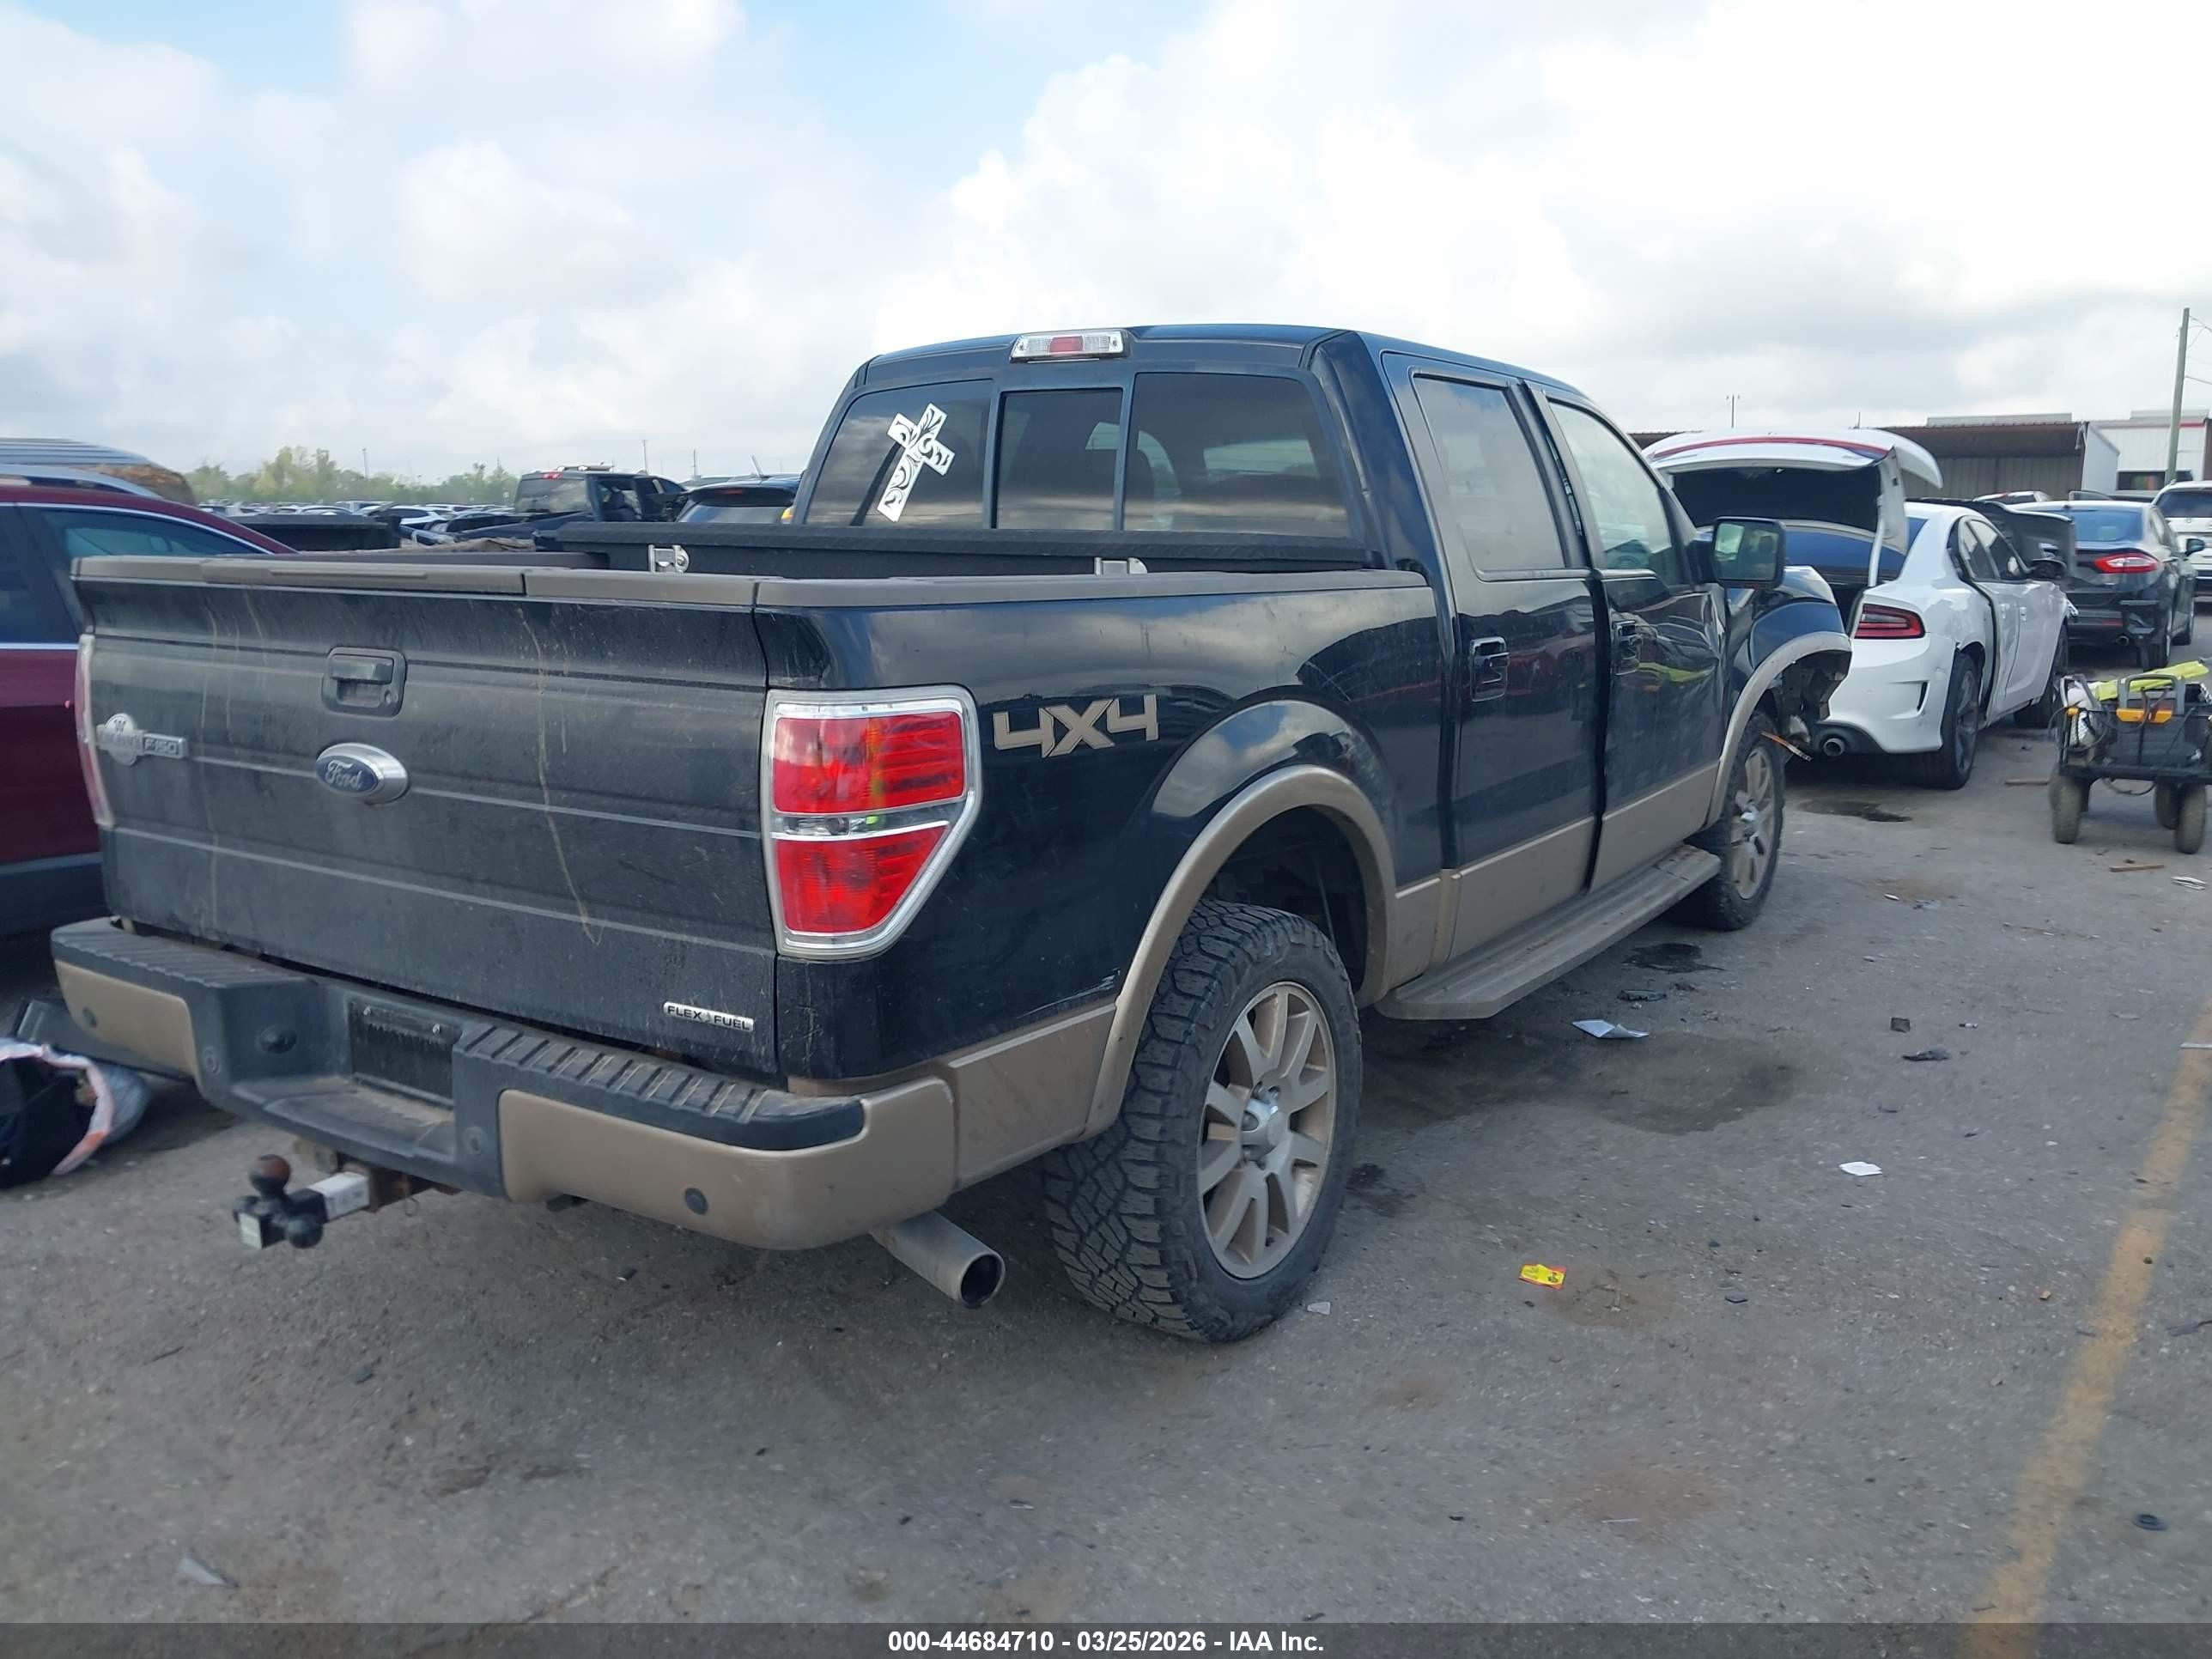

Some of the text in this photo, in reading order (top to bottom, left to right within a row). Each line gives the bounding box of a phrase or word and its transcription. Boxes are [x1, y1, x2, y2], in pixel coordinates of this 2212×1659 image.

[325, 759, 363, 791] Ford
[667, 1005, 750, 1030] FLEX FUEL
